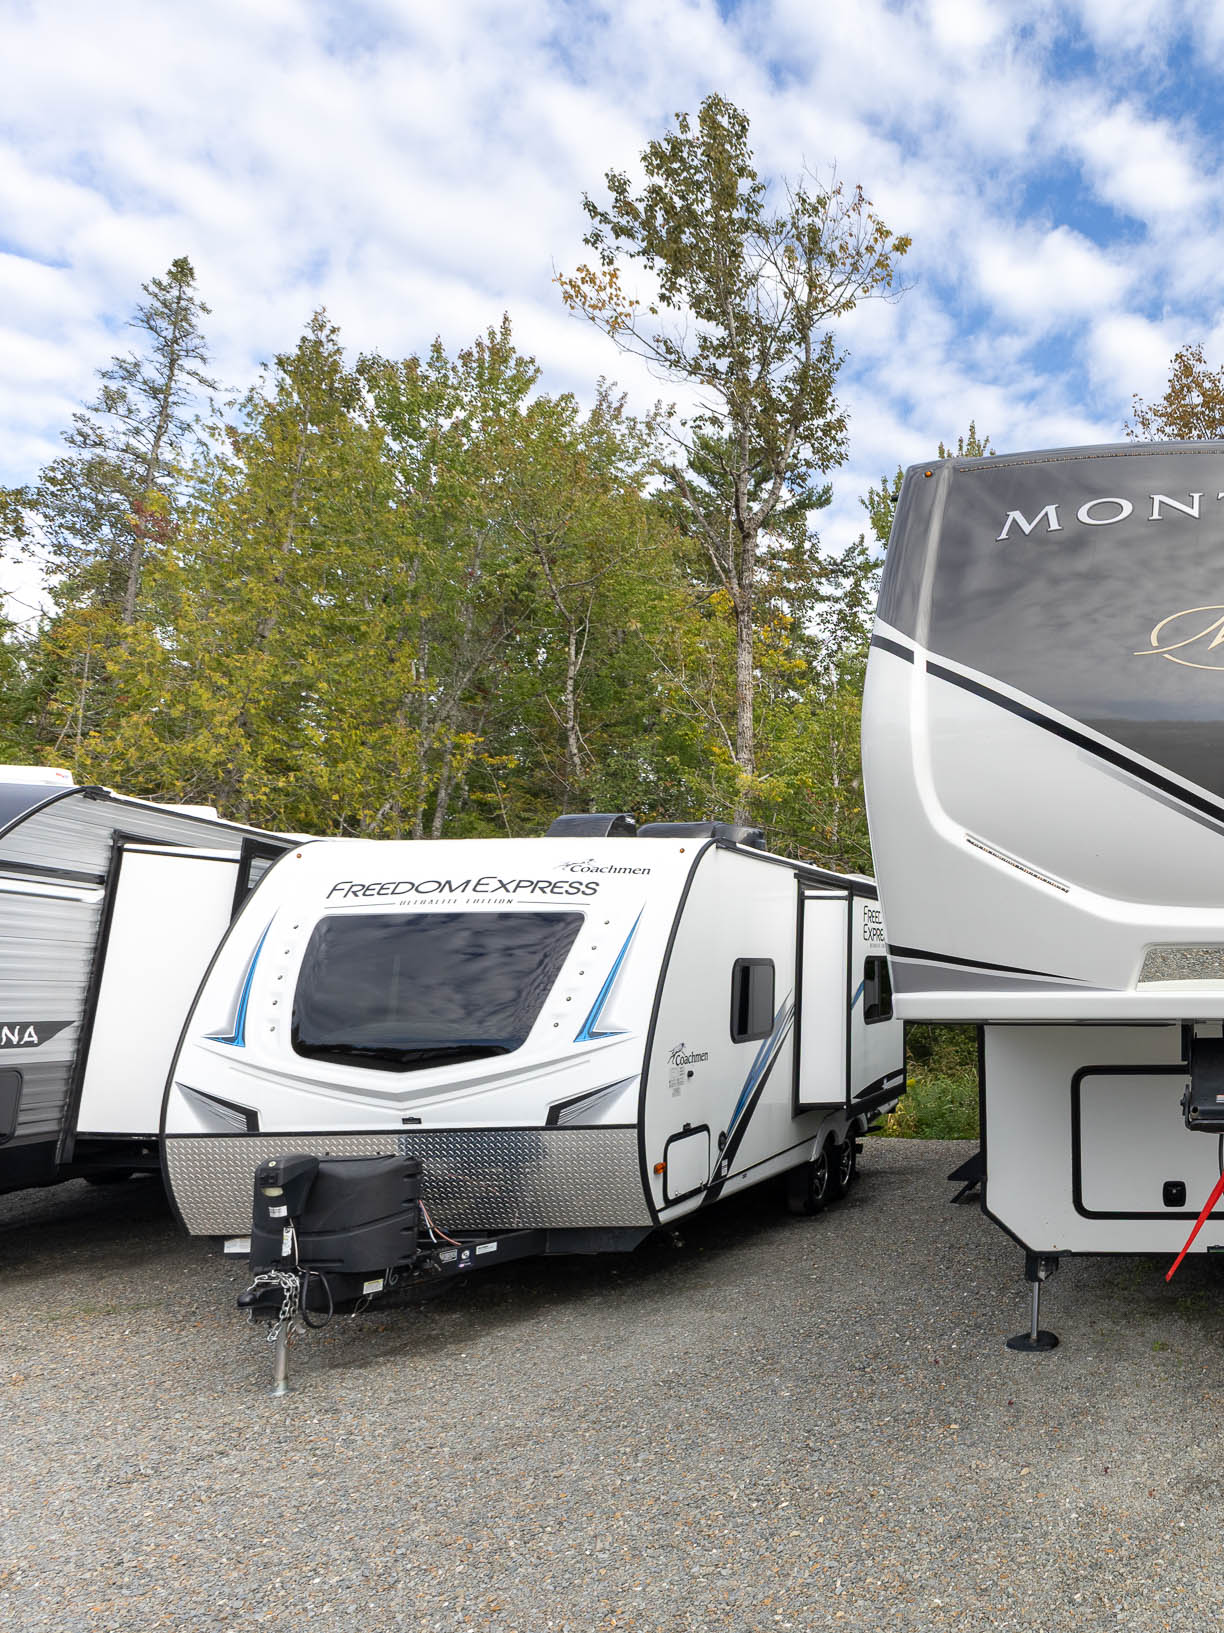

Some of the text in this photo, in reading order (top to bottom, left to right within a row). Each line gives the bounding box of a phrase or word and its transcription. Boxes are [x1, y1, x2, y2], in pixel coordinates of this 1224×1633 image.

[570, 863, 652, 876] Coachmen
[325, 876, 600, 900] FREEDOM EXPRESS
[675, 1051, 709, 1066] Coachmen
